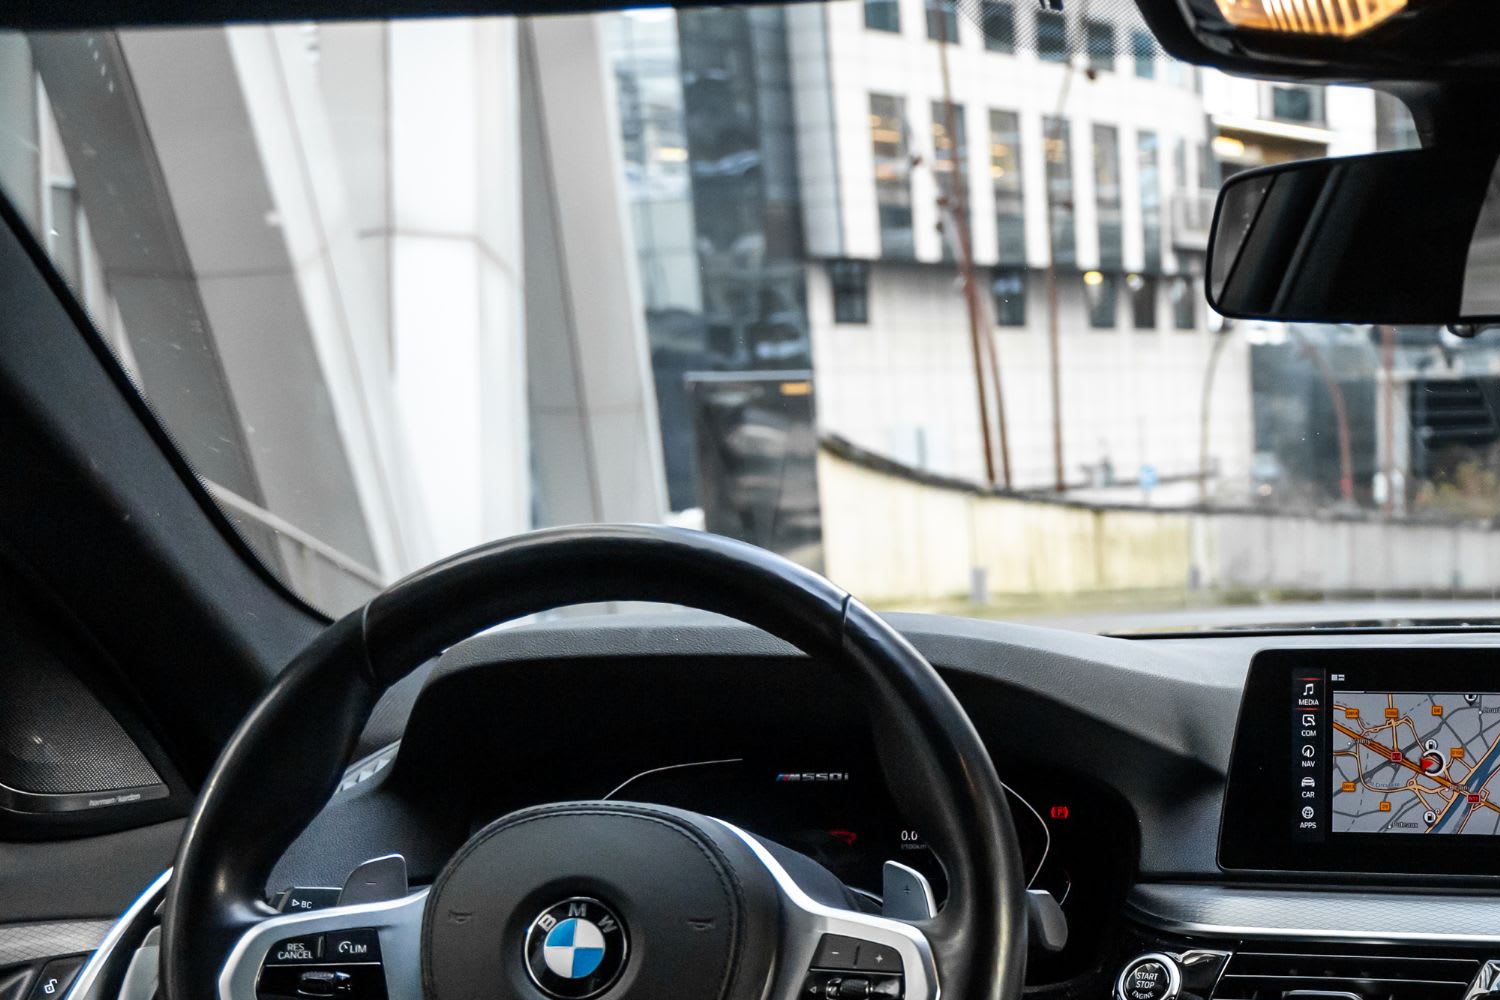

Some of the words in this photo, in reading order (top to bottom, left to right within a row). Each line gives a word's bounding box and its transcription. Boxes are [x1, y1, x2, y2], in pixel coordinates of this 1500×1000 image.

[1301, 729, 1317, 737] COM
[1301, 760, 1316, 768] NAV
[900, 830, 918, 841] 0.0
[301, 900, 312, 909] BC
[538, 902, 618, 934] BMW
[286, 943, 305, 951] RES
[349, 944, 367, 954] LIM
[277, 951, 313, 960] CANCEL
[1136, 972, 1159, 981] START
[1135, 981, 1155, 989] STOP
[1131, 990, 1155, 1000] ENGINE
